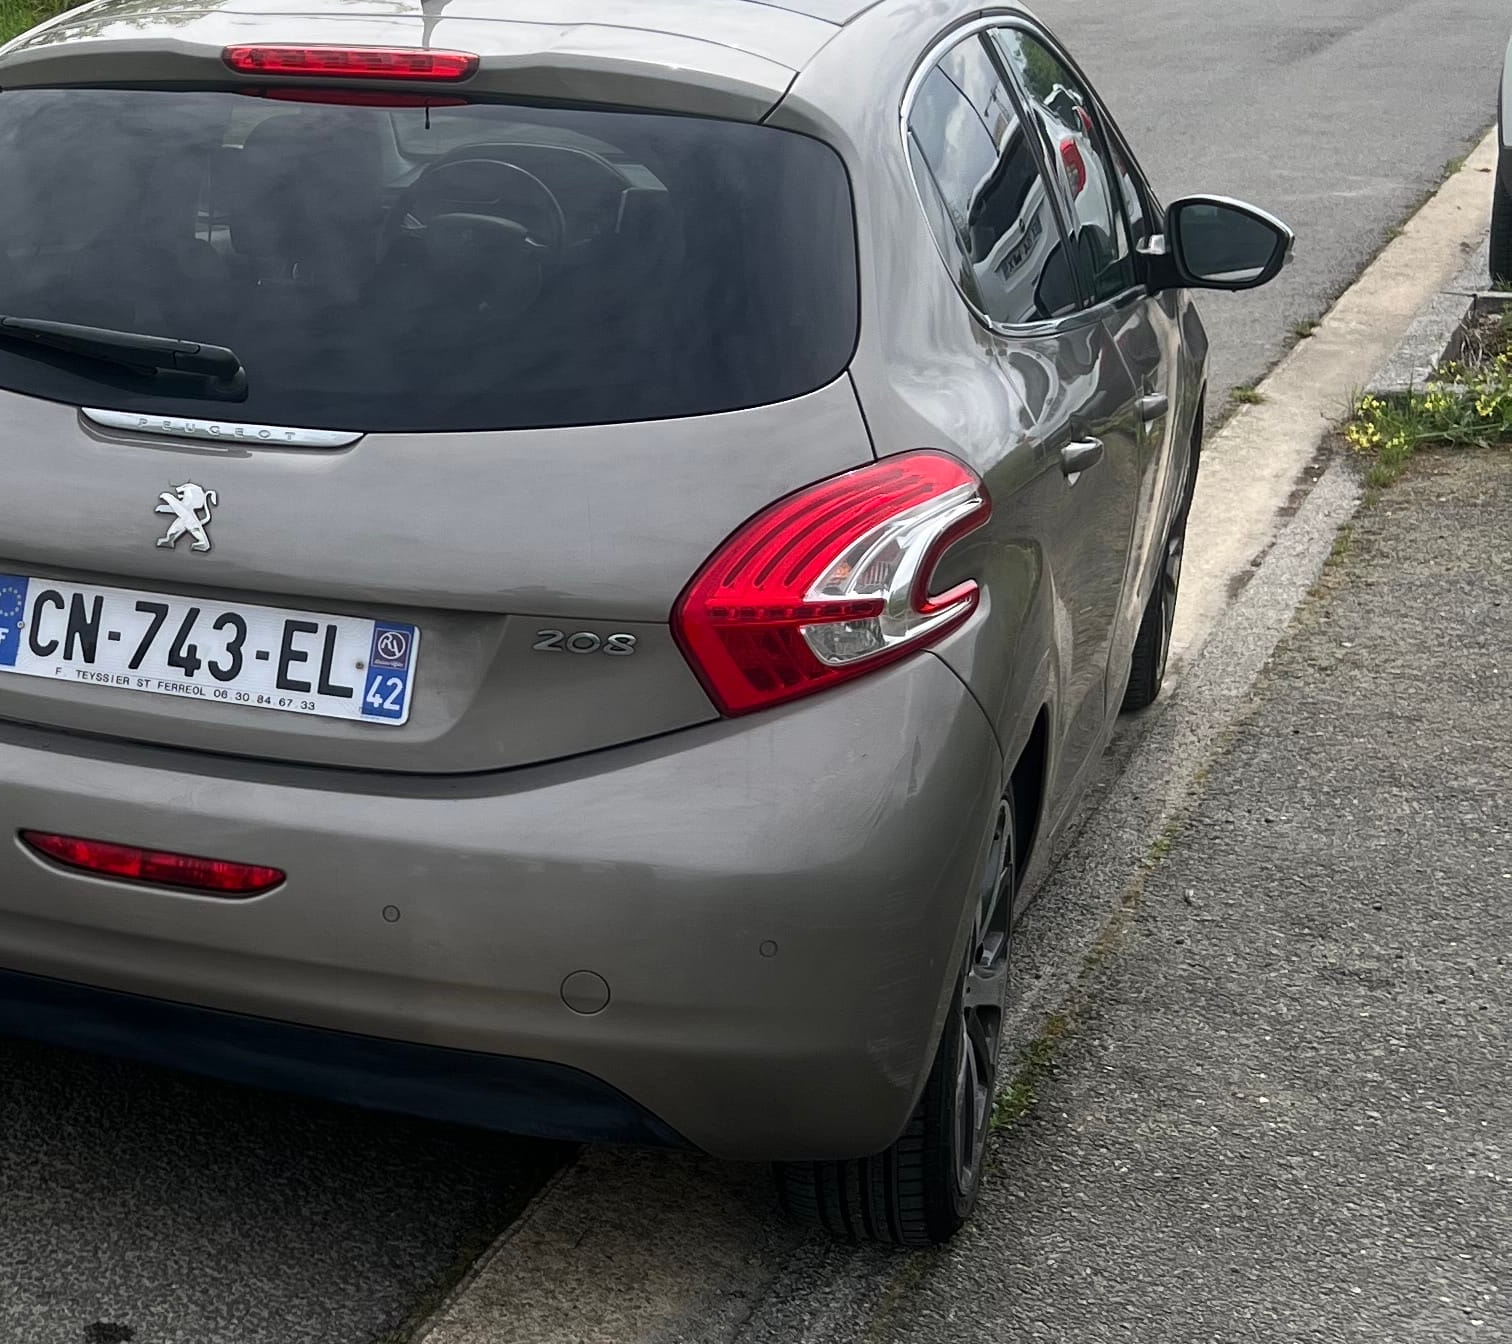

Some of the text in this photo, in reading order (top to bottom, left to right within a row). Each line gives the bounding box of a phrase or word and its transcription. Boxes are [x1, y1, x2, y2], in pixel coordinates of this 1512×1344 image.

[138, 417, 296, 441] PEUGEOT
[29, 589, 354, 699] CN-743-EL
[532, 629, 637, 655] 208
[76, 669, 130, 686] TEYSSIER
[136, 678, 151, 688] ST
[157, 681, 206, 696] FERREOL
[366, 675, 404, 711] 42
